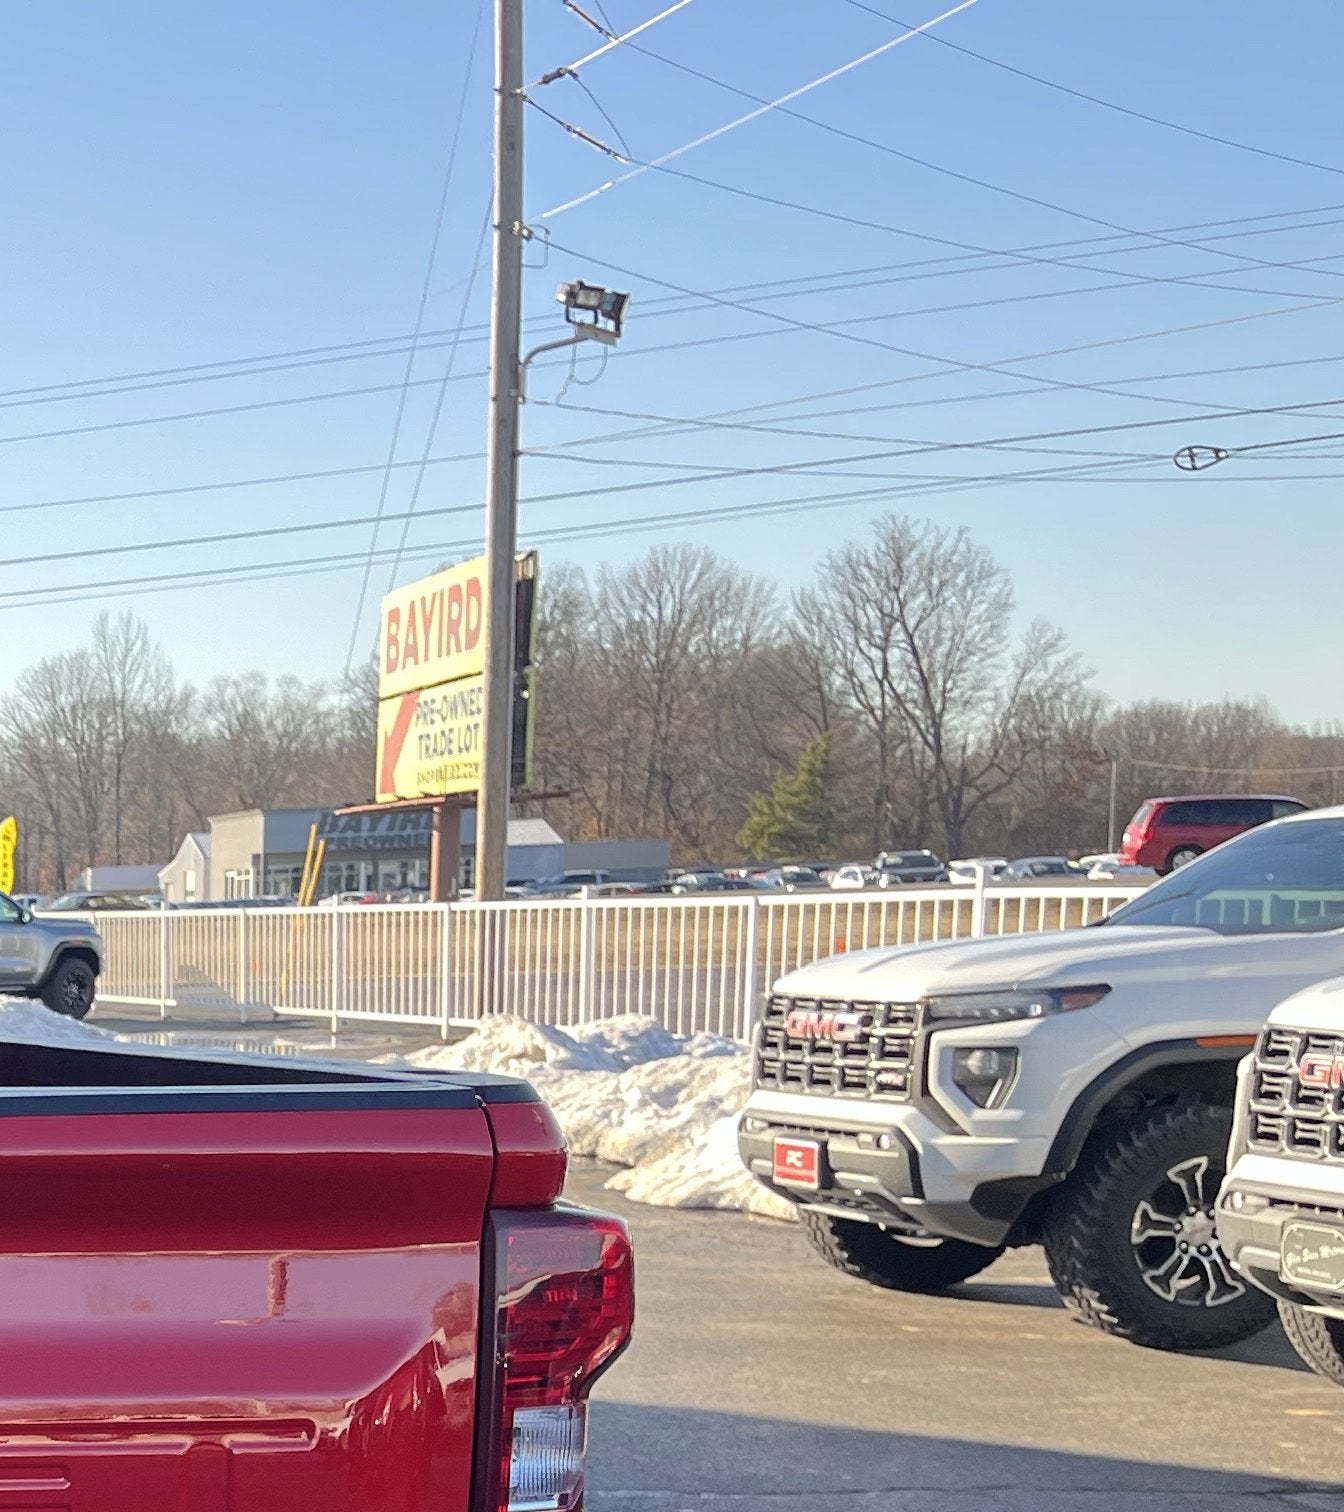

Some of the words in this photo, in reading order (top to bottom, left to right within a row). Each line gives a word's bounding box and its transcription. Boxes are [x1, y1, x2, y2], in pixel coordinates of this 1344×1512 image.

[386, 576, 482, 674] BAYIRD
[418, 727, 454, 761] TRADE
[458, 722, 480, 754] LOT
[786, 1011, 863, 1041] GMC
